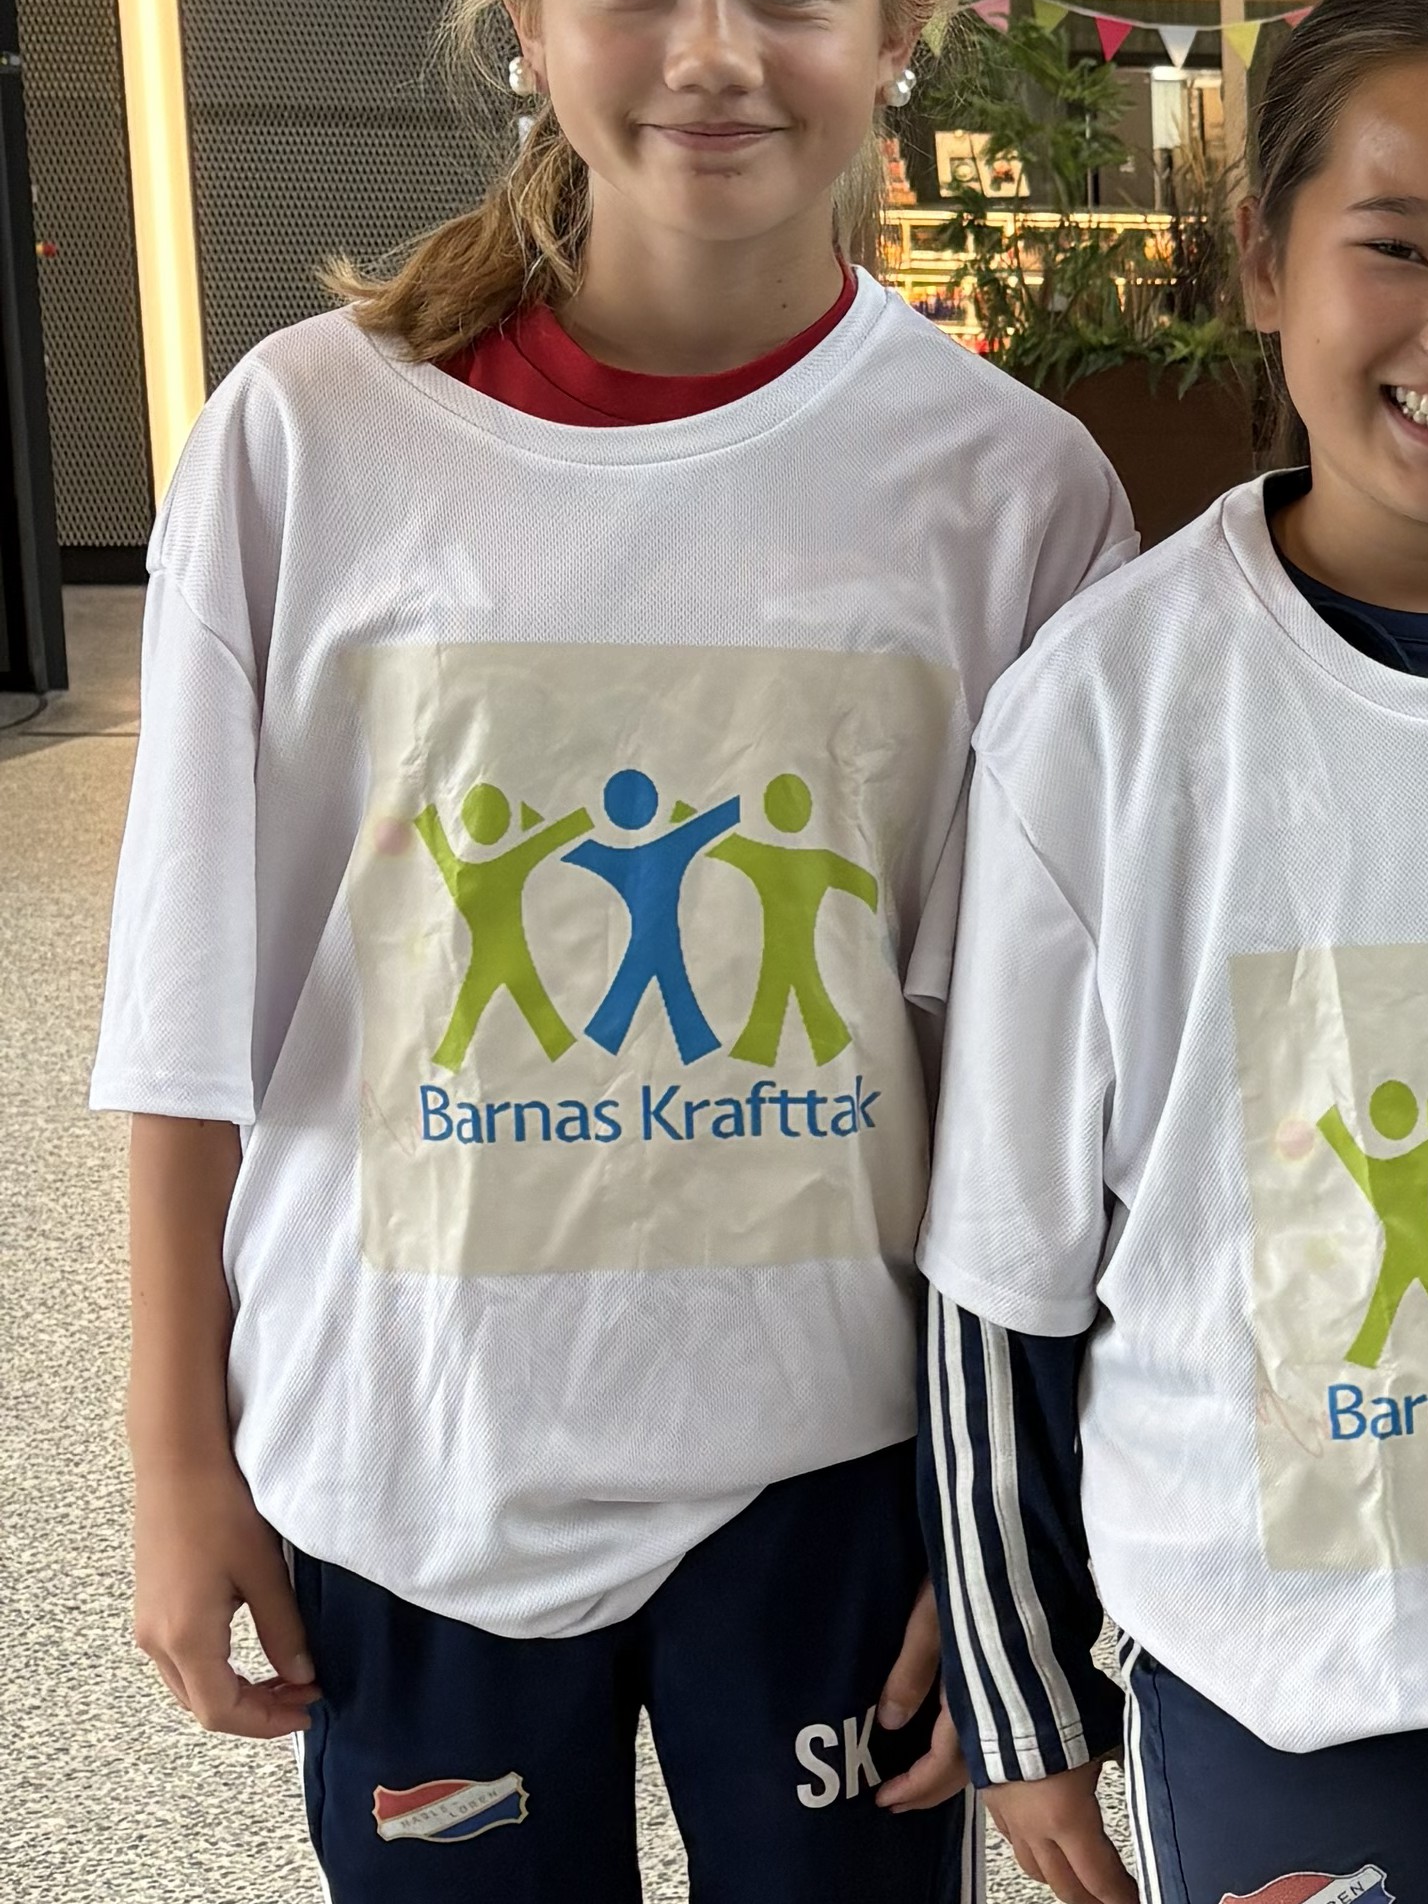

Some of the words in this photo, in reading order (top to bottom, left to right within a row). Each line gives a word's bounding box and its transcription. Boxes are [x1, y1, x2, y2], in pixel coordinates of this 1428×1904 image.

[420, 1084, 622, 1143] Barnas
[641, 1075, 882, 1141] Krafttak
[795, 1704, 882, 1808] SK
